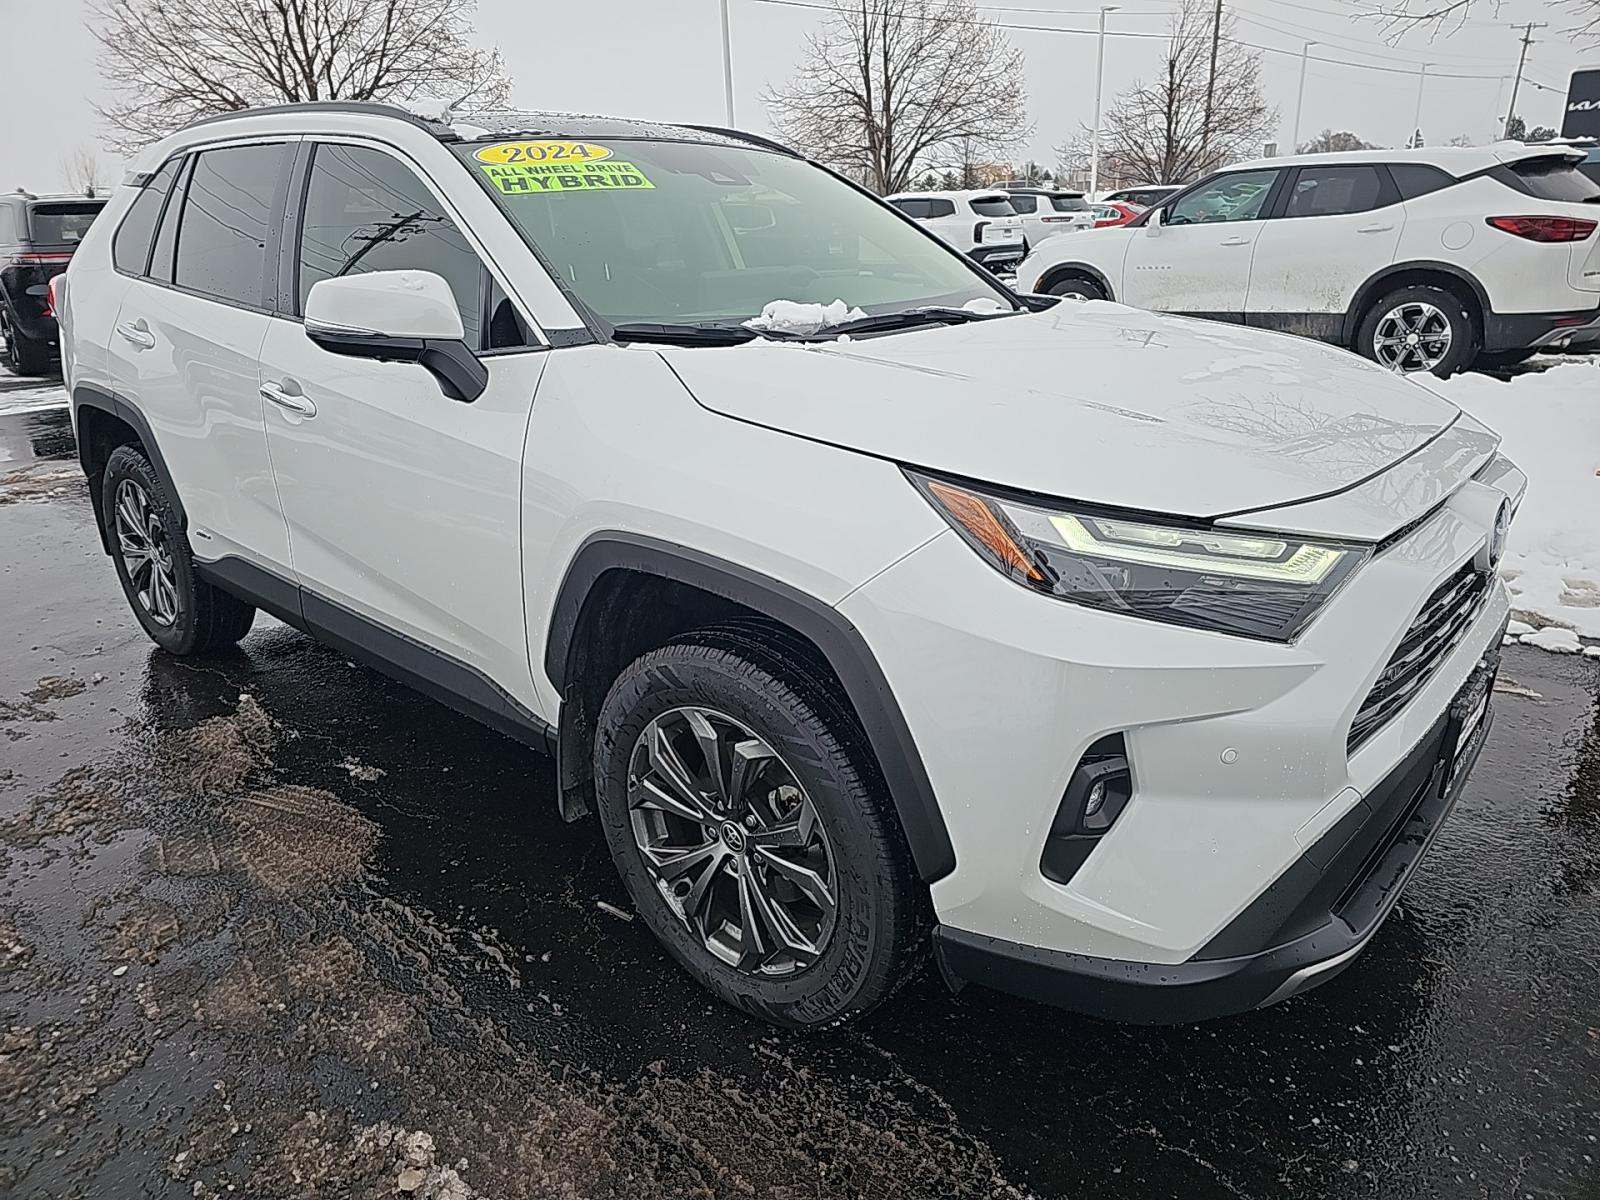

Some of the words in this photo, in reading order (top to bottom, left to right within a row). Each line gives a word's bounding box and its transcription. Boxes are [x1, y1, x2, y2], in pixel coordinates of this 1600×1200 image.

[502, 143, 593, 163] 2024
[490, 166, 519, 177] ALL
[526, 163, 581, 175] WHEEL
[586, 162, 634, 174] DRIVE
[501, 173, 645, 192] HYBRID
